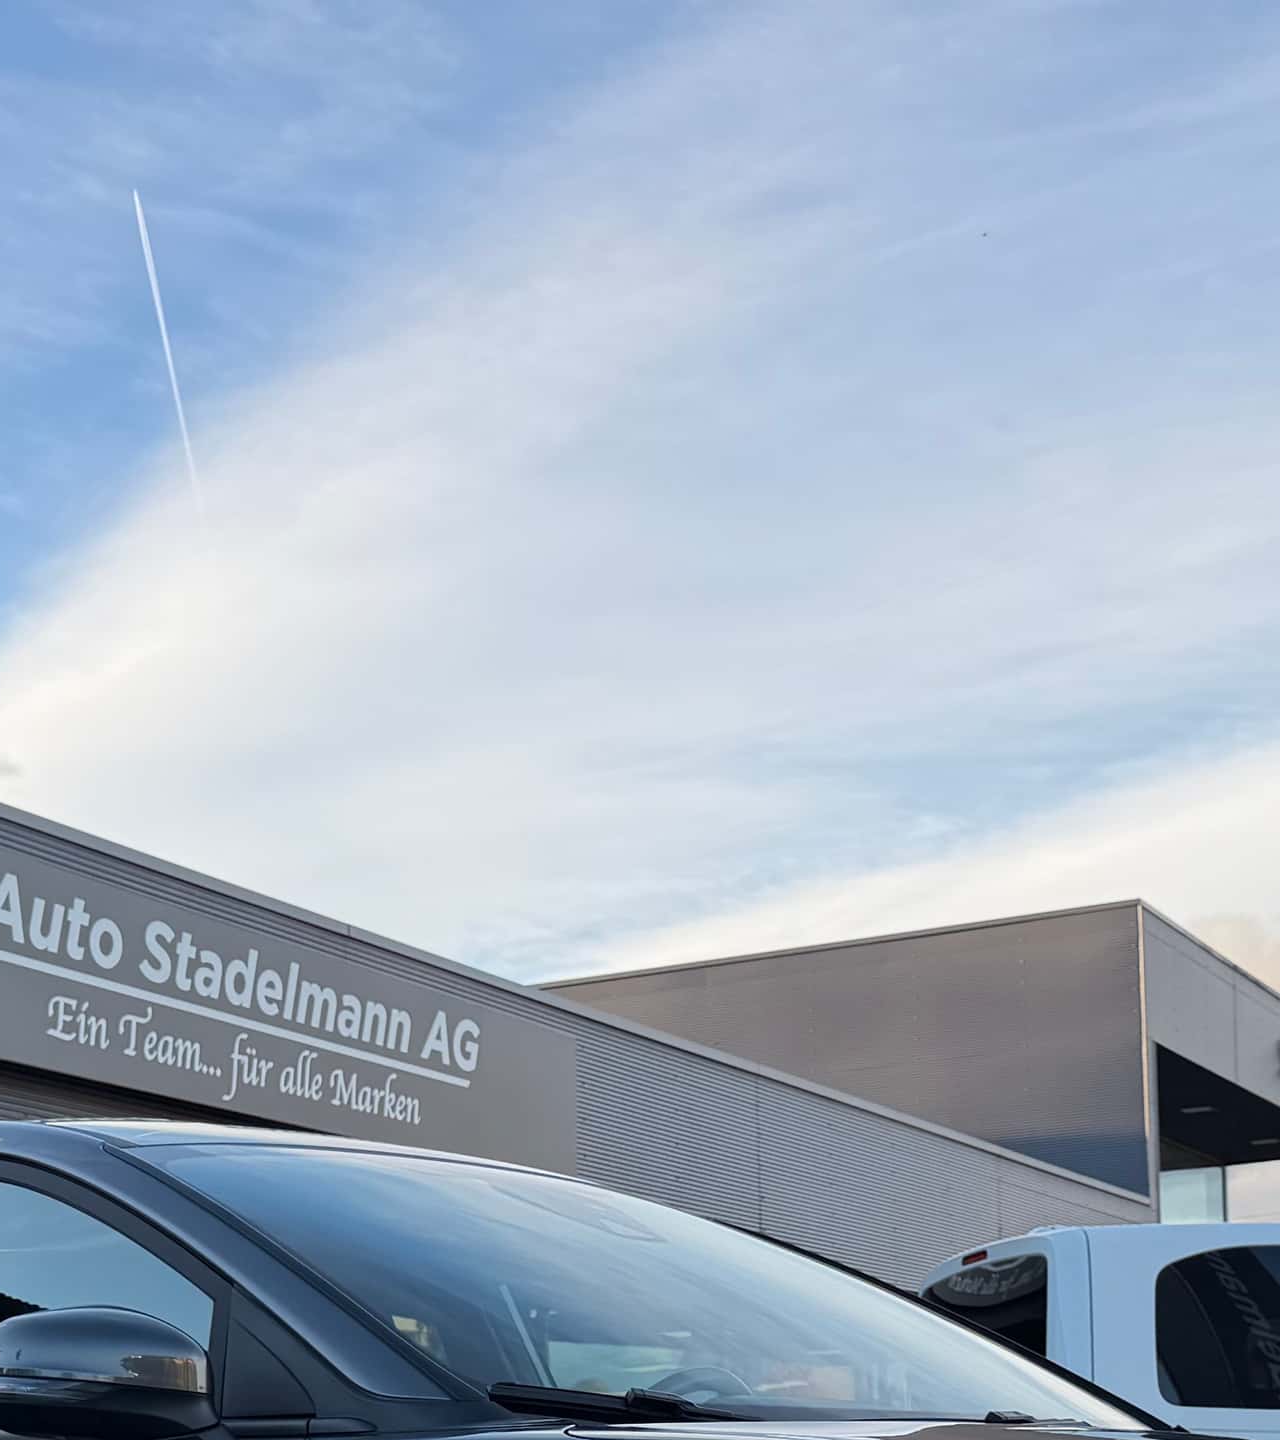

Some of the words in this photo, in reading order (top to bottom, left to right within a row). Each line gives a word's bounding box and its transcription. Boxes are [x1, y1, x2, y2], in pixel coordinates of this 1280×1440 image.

[45, 995, 110, 1050] Ein
[117, 1005, 222, 1079] Team...
[222, 1032, 275, 1101] für
[279, 1049, 324, 1101] alle
[329, 1068, 422, 1125] Marken
[138, 919, 412, 1053] Stadelmann
[420, 1009, 481, 1073] AG
